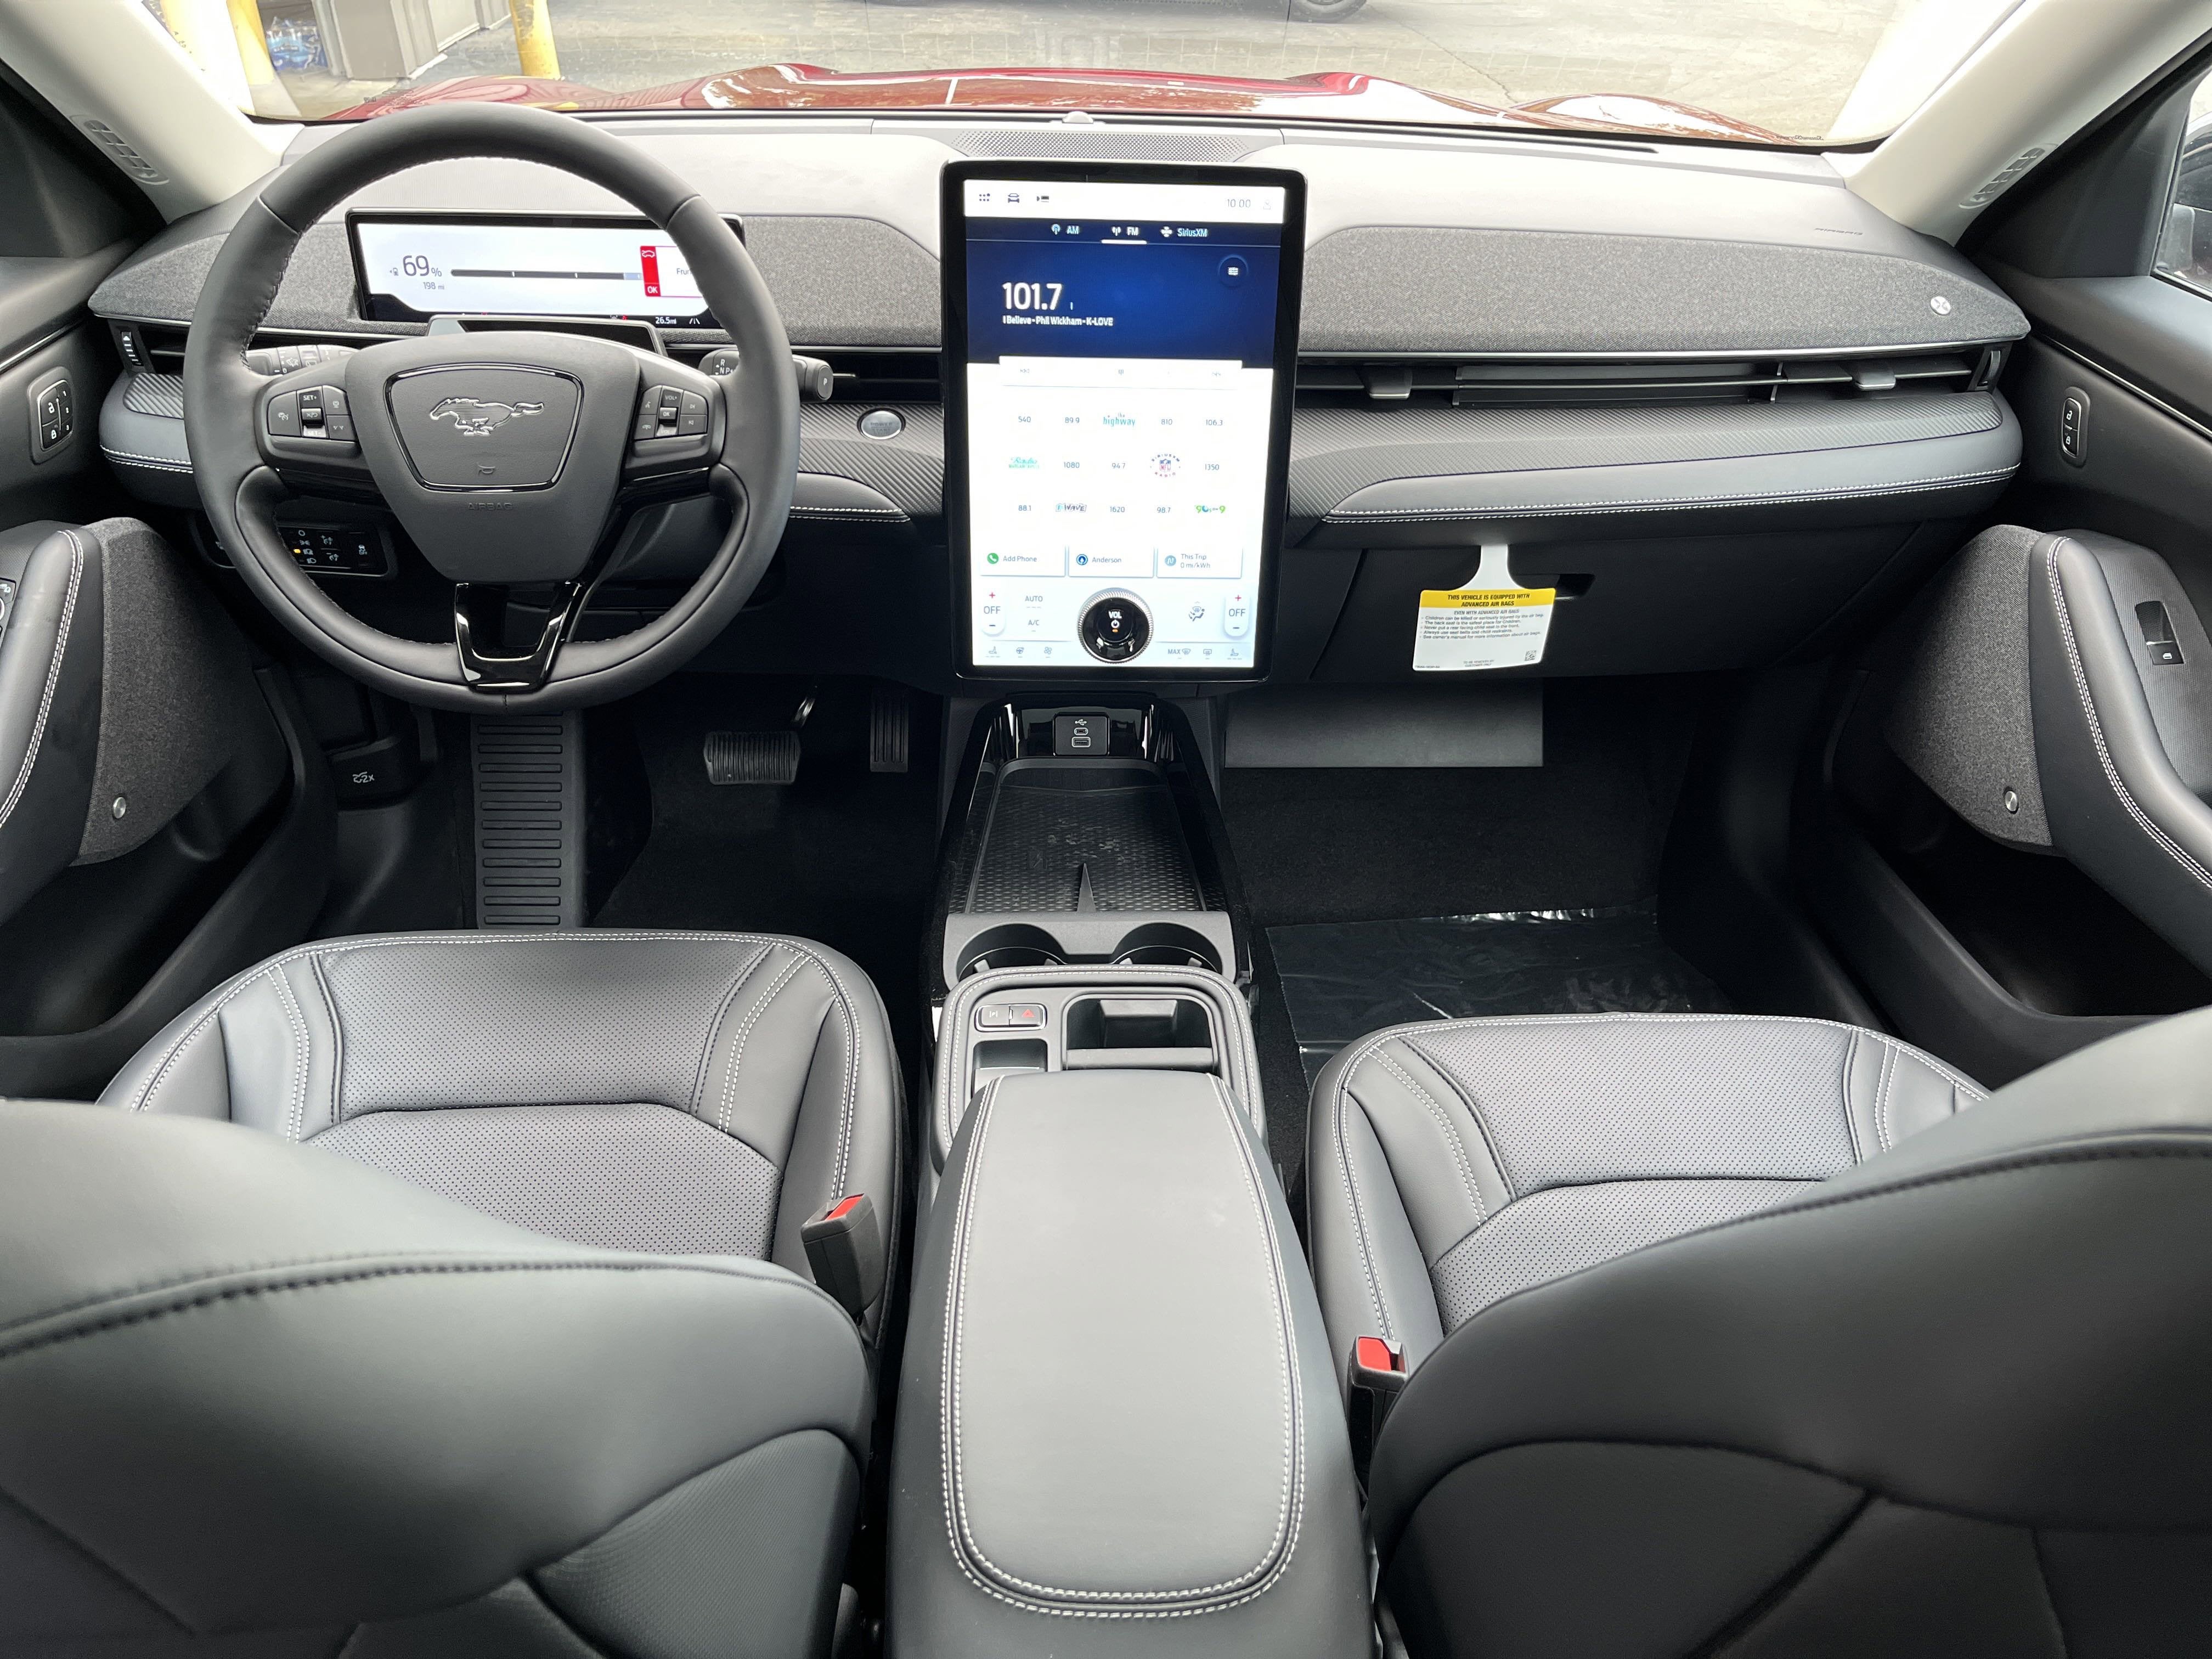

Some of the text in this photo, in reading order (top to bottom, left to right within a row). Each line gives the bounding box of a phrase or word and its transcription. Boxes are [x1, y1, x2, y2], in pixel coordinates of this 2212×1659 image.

[1066, 225, 1080, 235] AM
[1126, 227, 1139, 236] FM
[1177, 228, 1207, 237] SiriusXM
[423, 281, 436, 290] 198
[1002, 282, 1063, 311] 101.7
[1036, 316, 1049, 325] Phil
[1051, 317, 1082, 325] Wickham
[1086, 317, 1114, 326] K-LOVE
[823, 377, 828, 386] P
[1103, 415, 1136, 427] highway
[983, 606, 1001, 614] OFF
[1228, 608, 1246, 617] OFF
[1108, 611, 1122, 619] VOL
[361, 774, 375, 783] 2x
